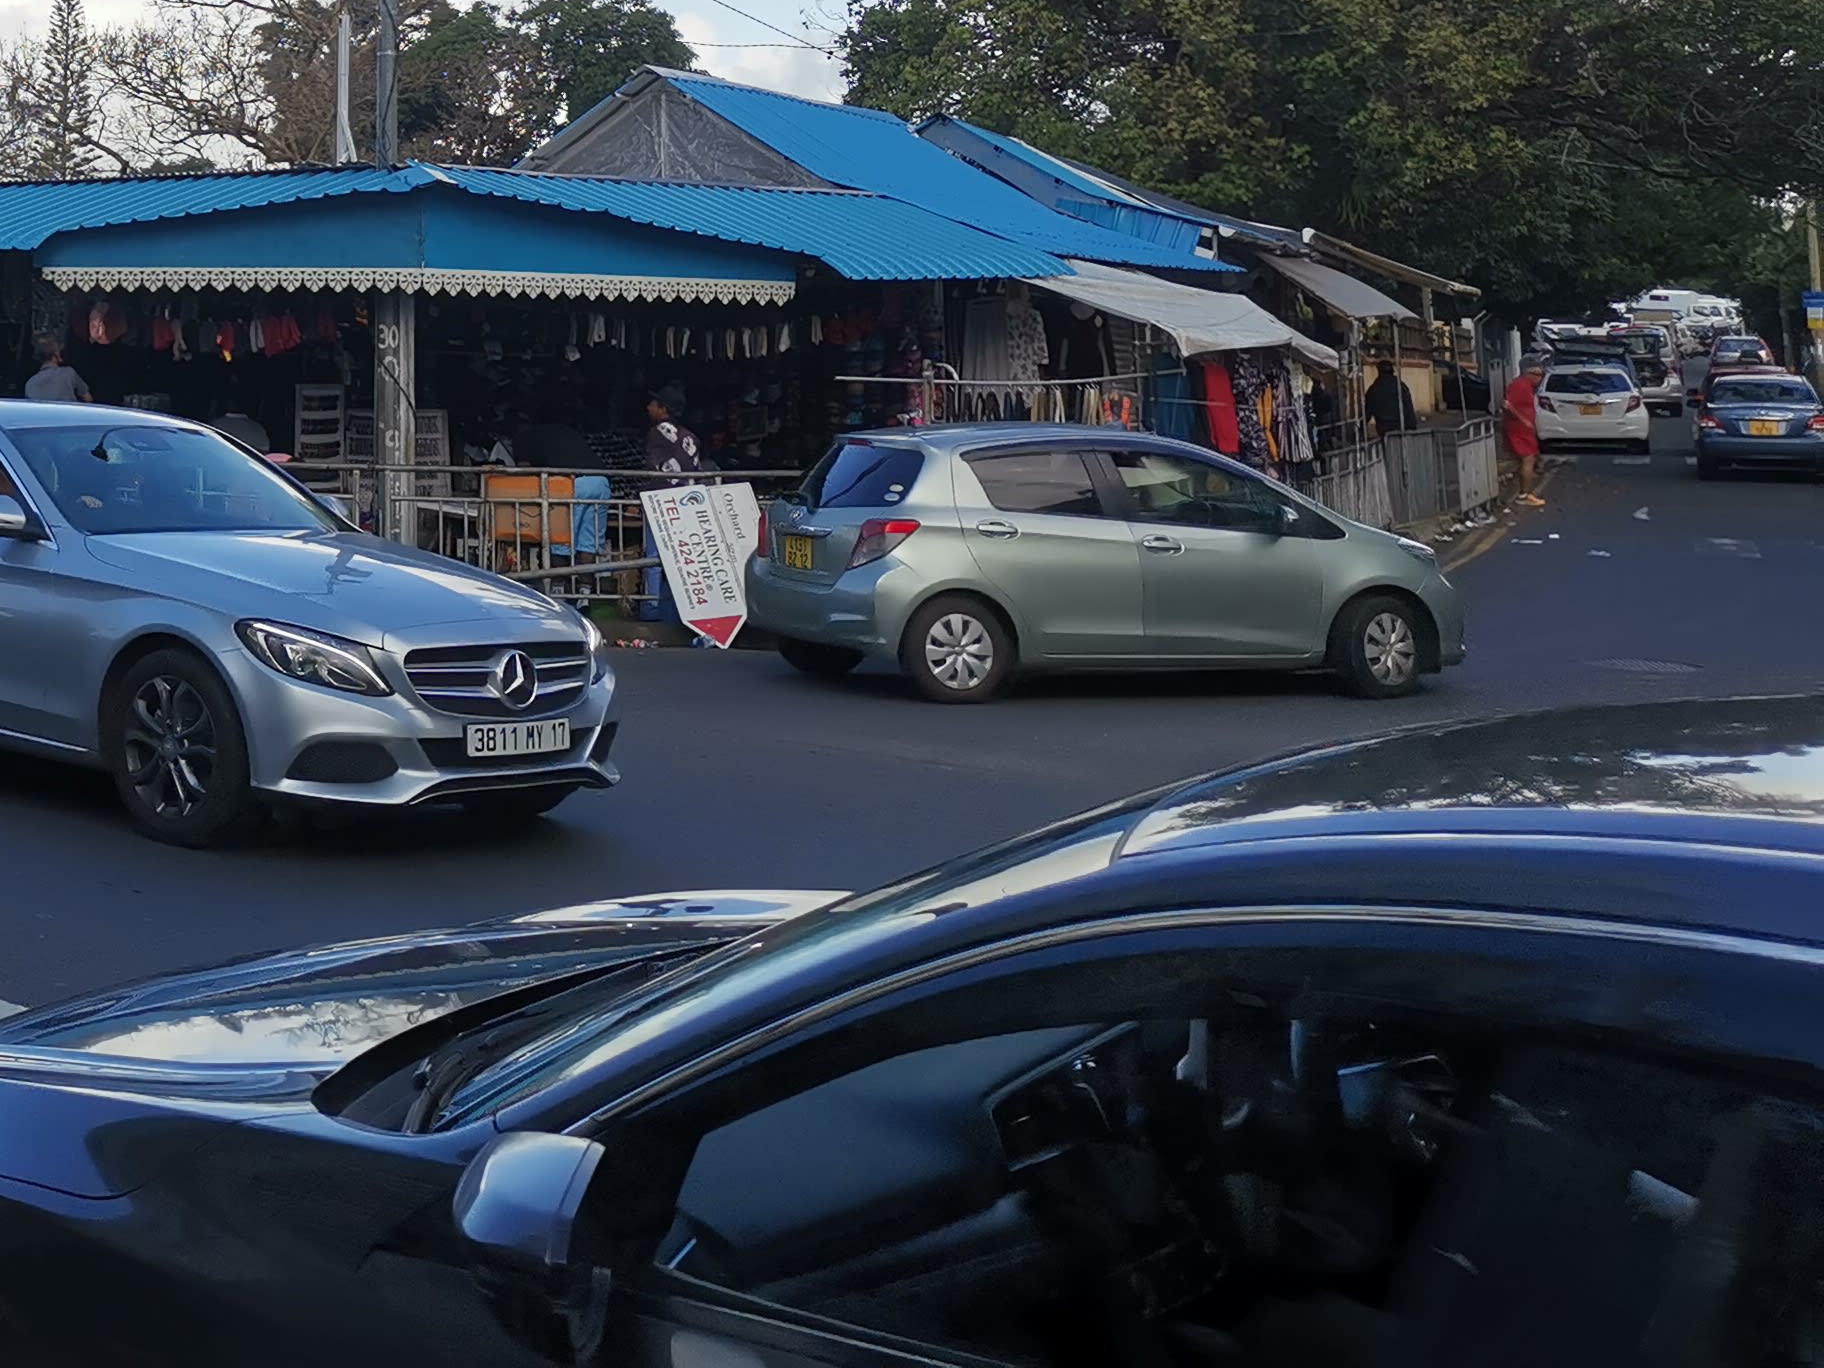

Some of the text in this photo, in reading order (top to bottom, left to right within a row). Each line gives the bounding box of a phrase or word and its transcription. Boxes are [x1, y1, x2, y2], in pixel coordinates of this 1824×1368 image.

[378, 324, 399, 348] 30
[723, 493, 746, 539] Orchard
[678, 539, 695, 566] 424
[695, 510, 736, 604] HEARING CARE
[686, 569, 708, 606] 2184
[474, 722, 566, 752] 3811 MY 17
